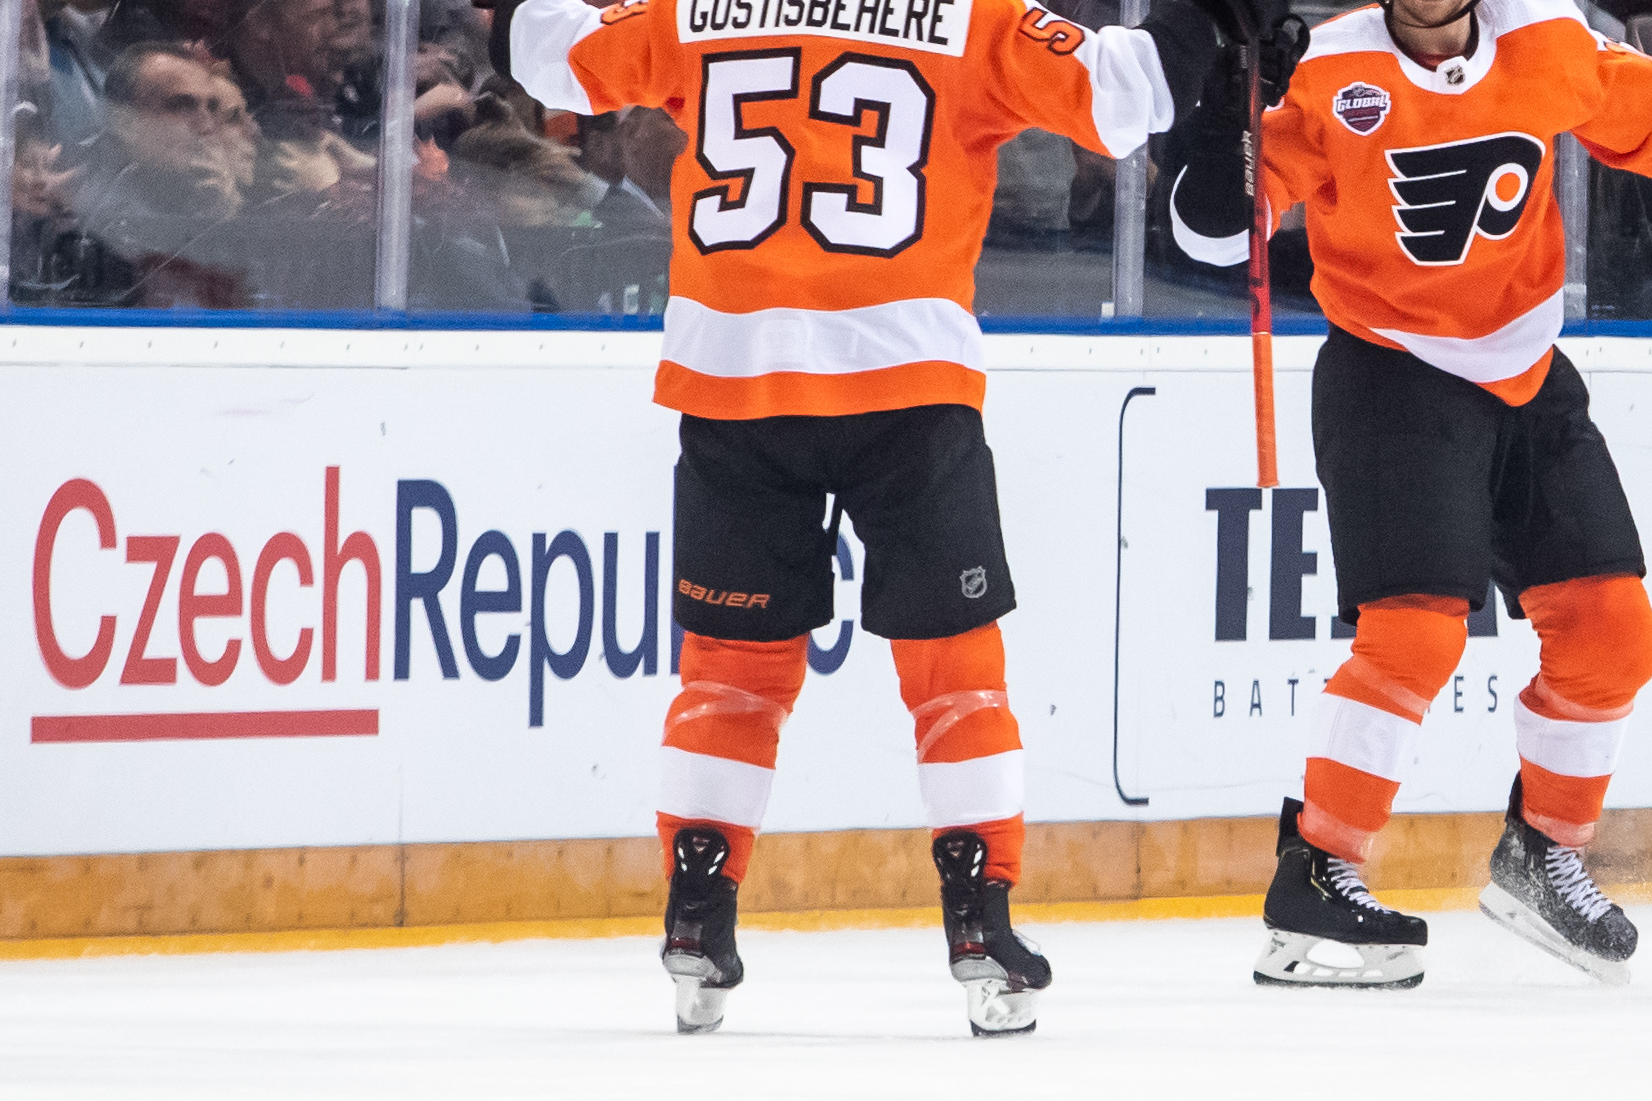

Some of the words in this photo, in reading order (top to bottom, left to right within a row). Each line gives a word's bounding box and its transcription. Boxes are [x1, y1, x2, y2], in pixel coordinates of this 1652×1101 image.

[689, 47, 937, 259] 53
[678, 578, 770, 609] BAUER
[1212, 674, 1499, 718] BATES
